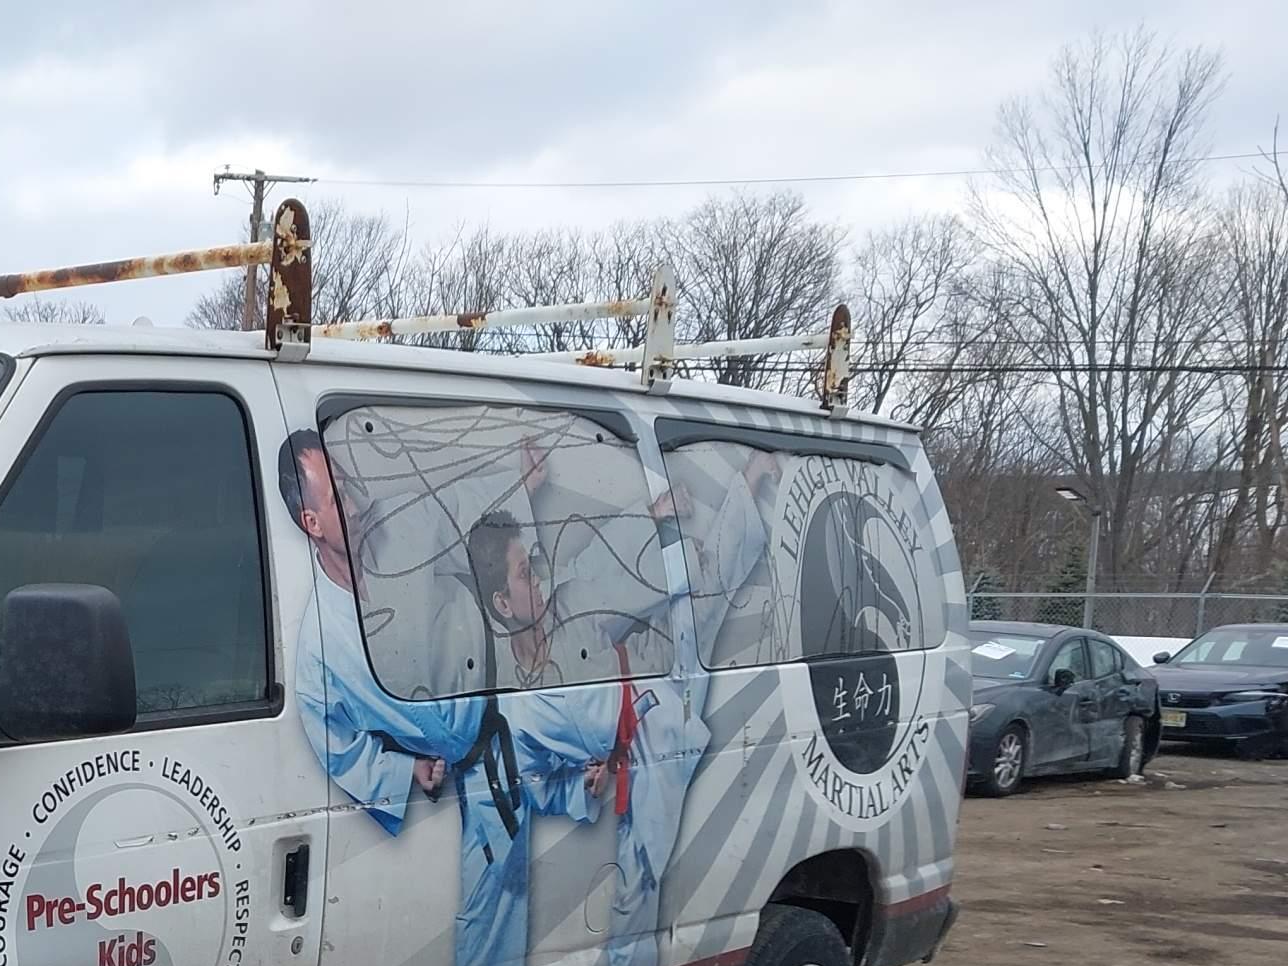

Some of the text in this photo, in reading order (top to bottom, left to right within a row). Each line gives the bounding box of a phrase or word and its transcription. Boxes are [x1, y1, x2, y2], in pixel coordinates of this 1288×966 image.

[780, 456, 923, 563] LEHIGH VALLEY
[831, 672, 893, 722] 生命力
[32, 750, 141, 824] CONFIDENCE
[160, 756, 242, 854] LEADERSHIP
[801, 714, 930, 821] MARTIAL ARTS
[25, 867, 222, 932] Pre-Schoolers
